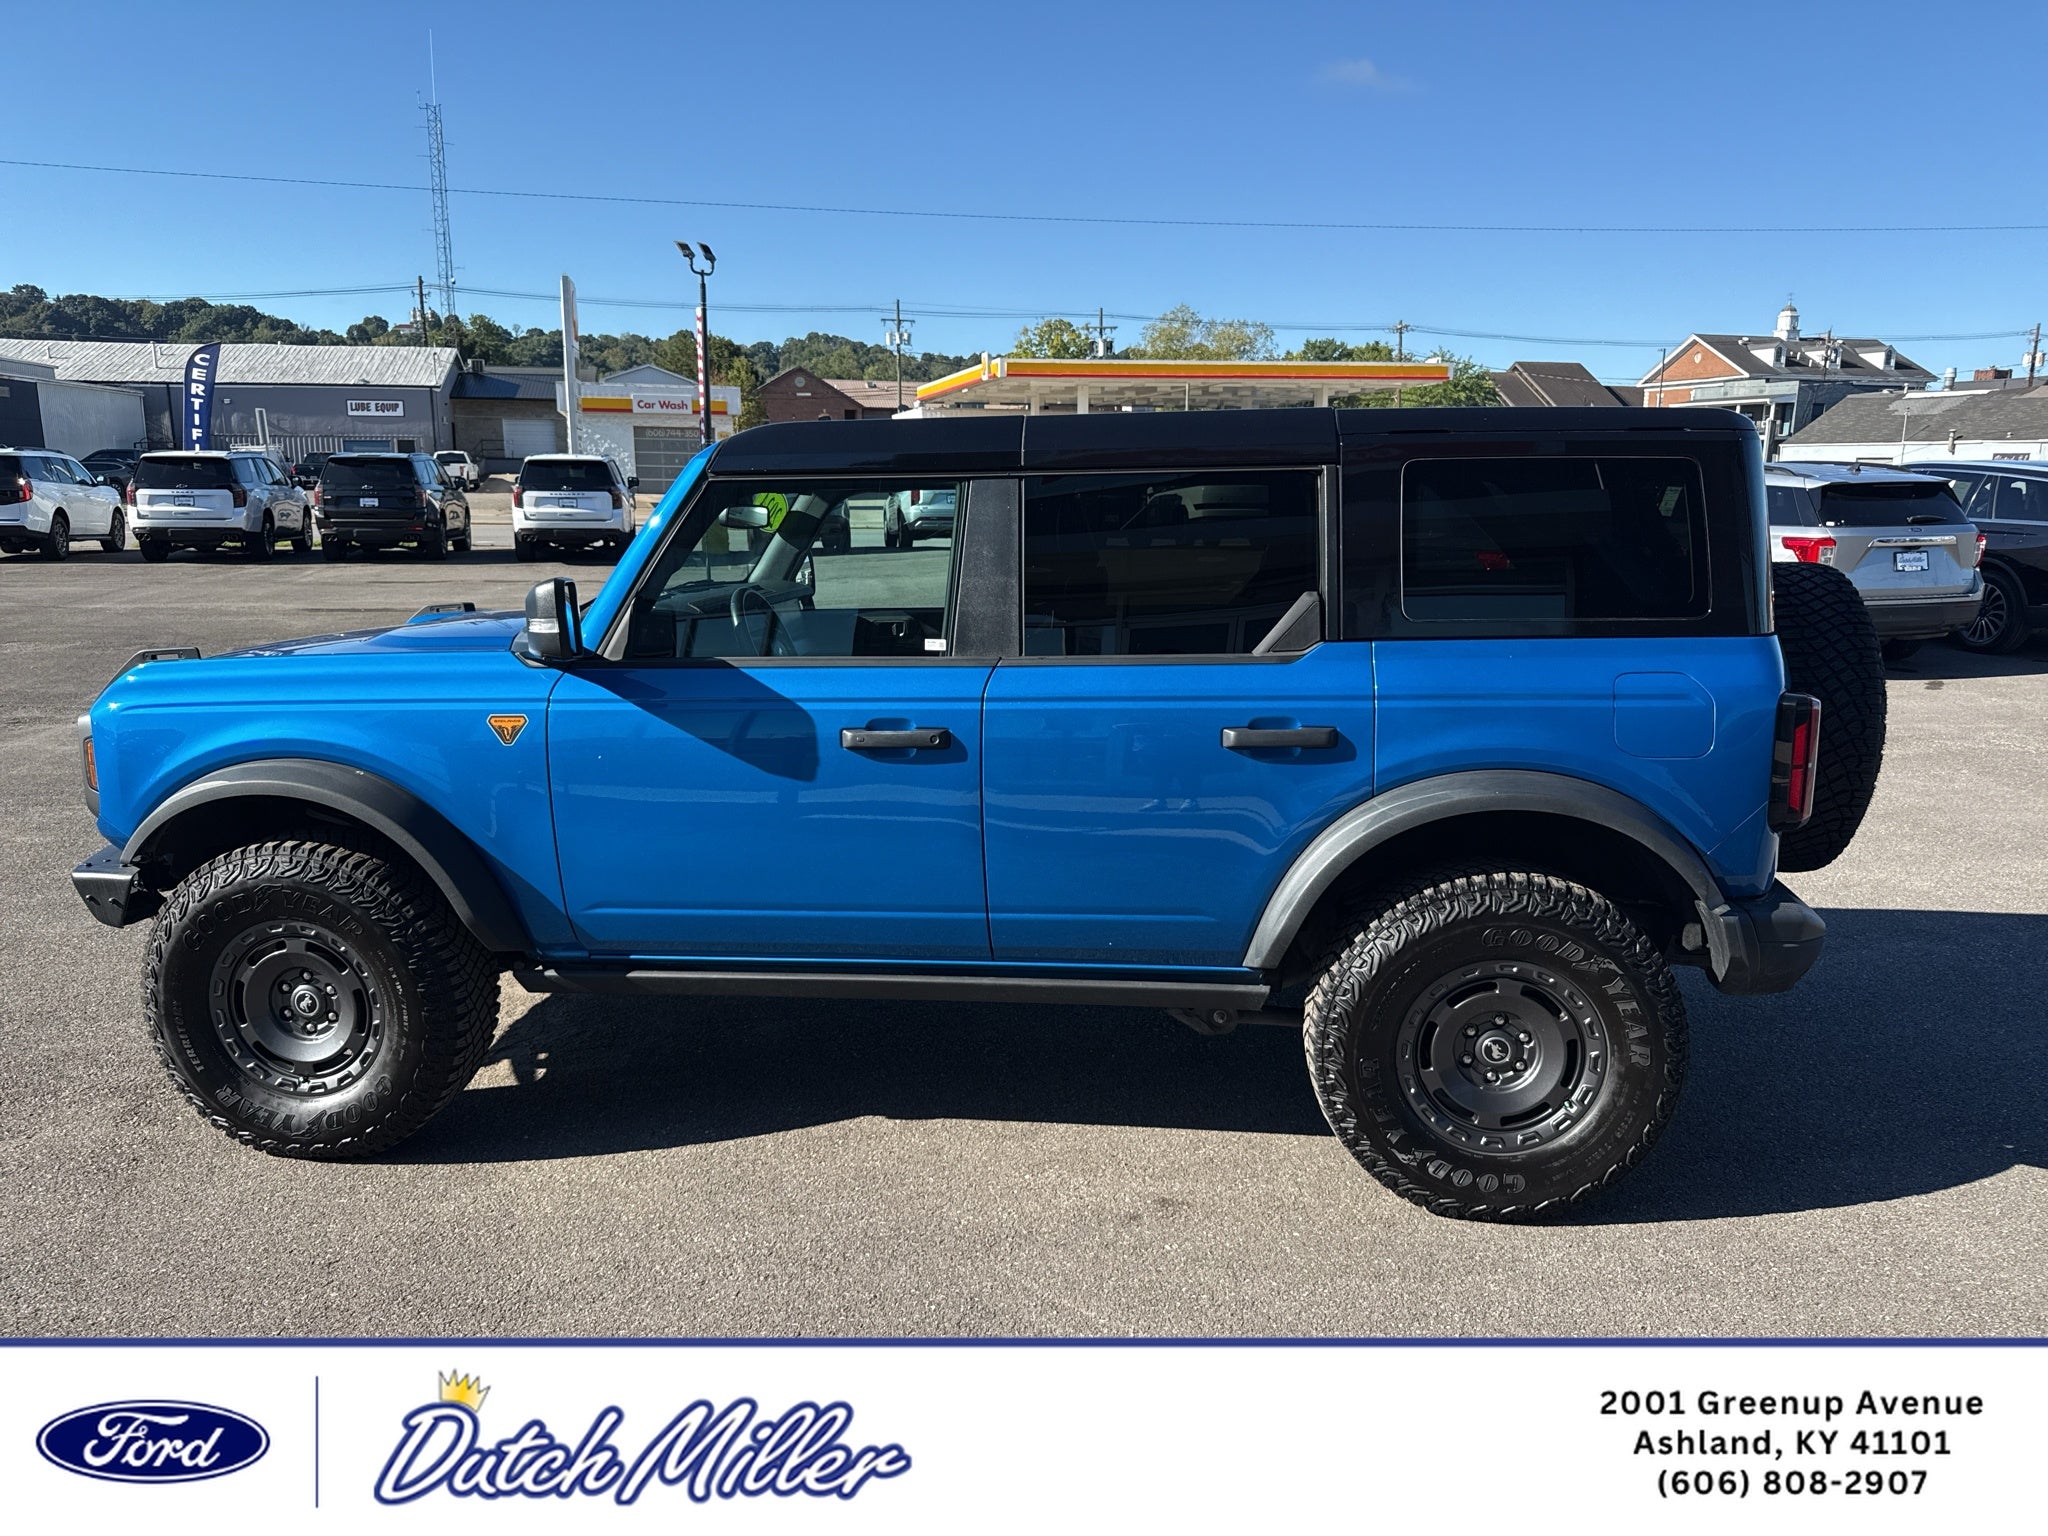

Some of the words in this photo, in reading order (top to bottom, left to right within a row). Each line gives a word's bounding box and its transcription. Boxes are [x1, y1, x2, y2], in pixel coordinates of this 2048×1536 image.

[350, 402, 372, 412] LUBE
[374, 402, 400, 413] EQUIP
[637, 400, 656, 409] Car
[658, 400, 688, 410] Wash
[1482, 927, 1651, 1067] GOODYEAR
[214, 1075, 394, 1140] GOODYEAR
